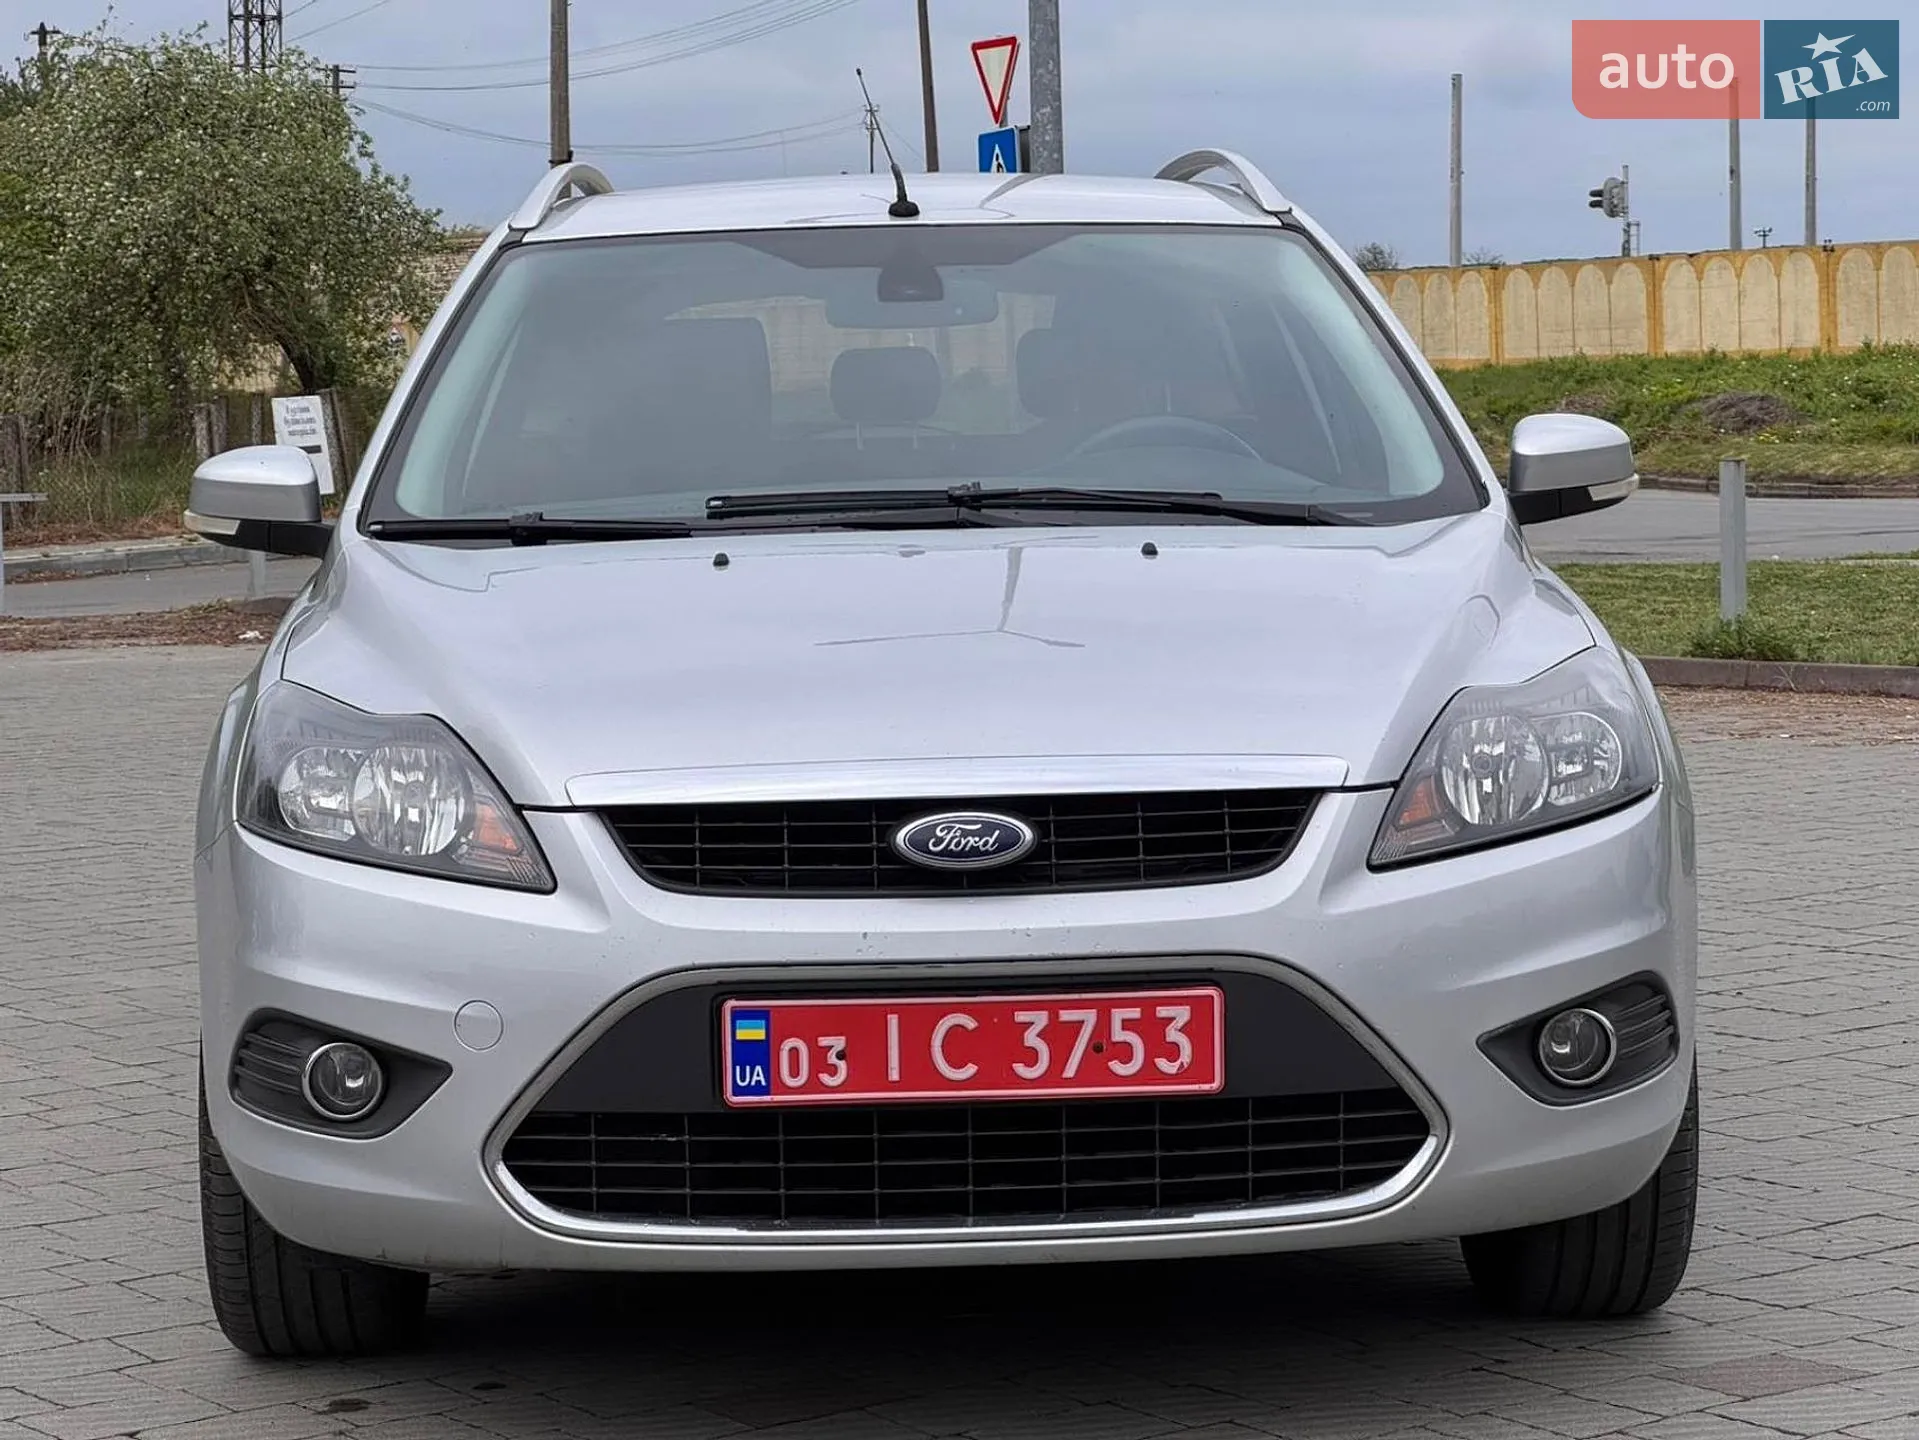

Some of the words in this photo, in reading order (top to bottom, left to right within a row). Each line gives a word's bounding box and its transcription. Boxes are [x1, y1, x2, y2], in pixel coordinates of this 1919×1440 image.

[928, 823, 1000, 851] Ford
[779, 1036, 848, 1088] 03
[1012, 1006, 1193, 1079] 3753
[735, 1066, 766, 1086] UA
